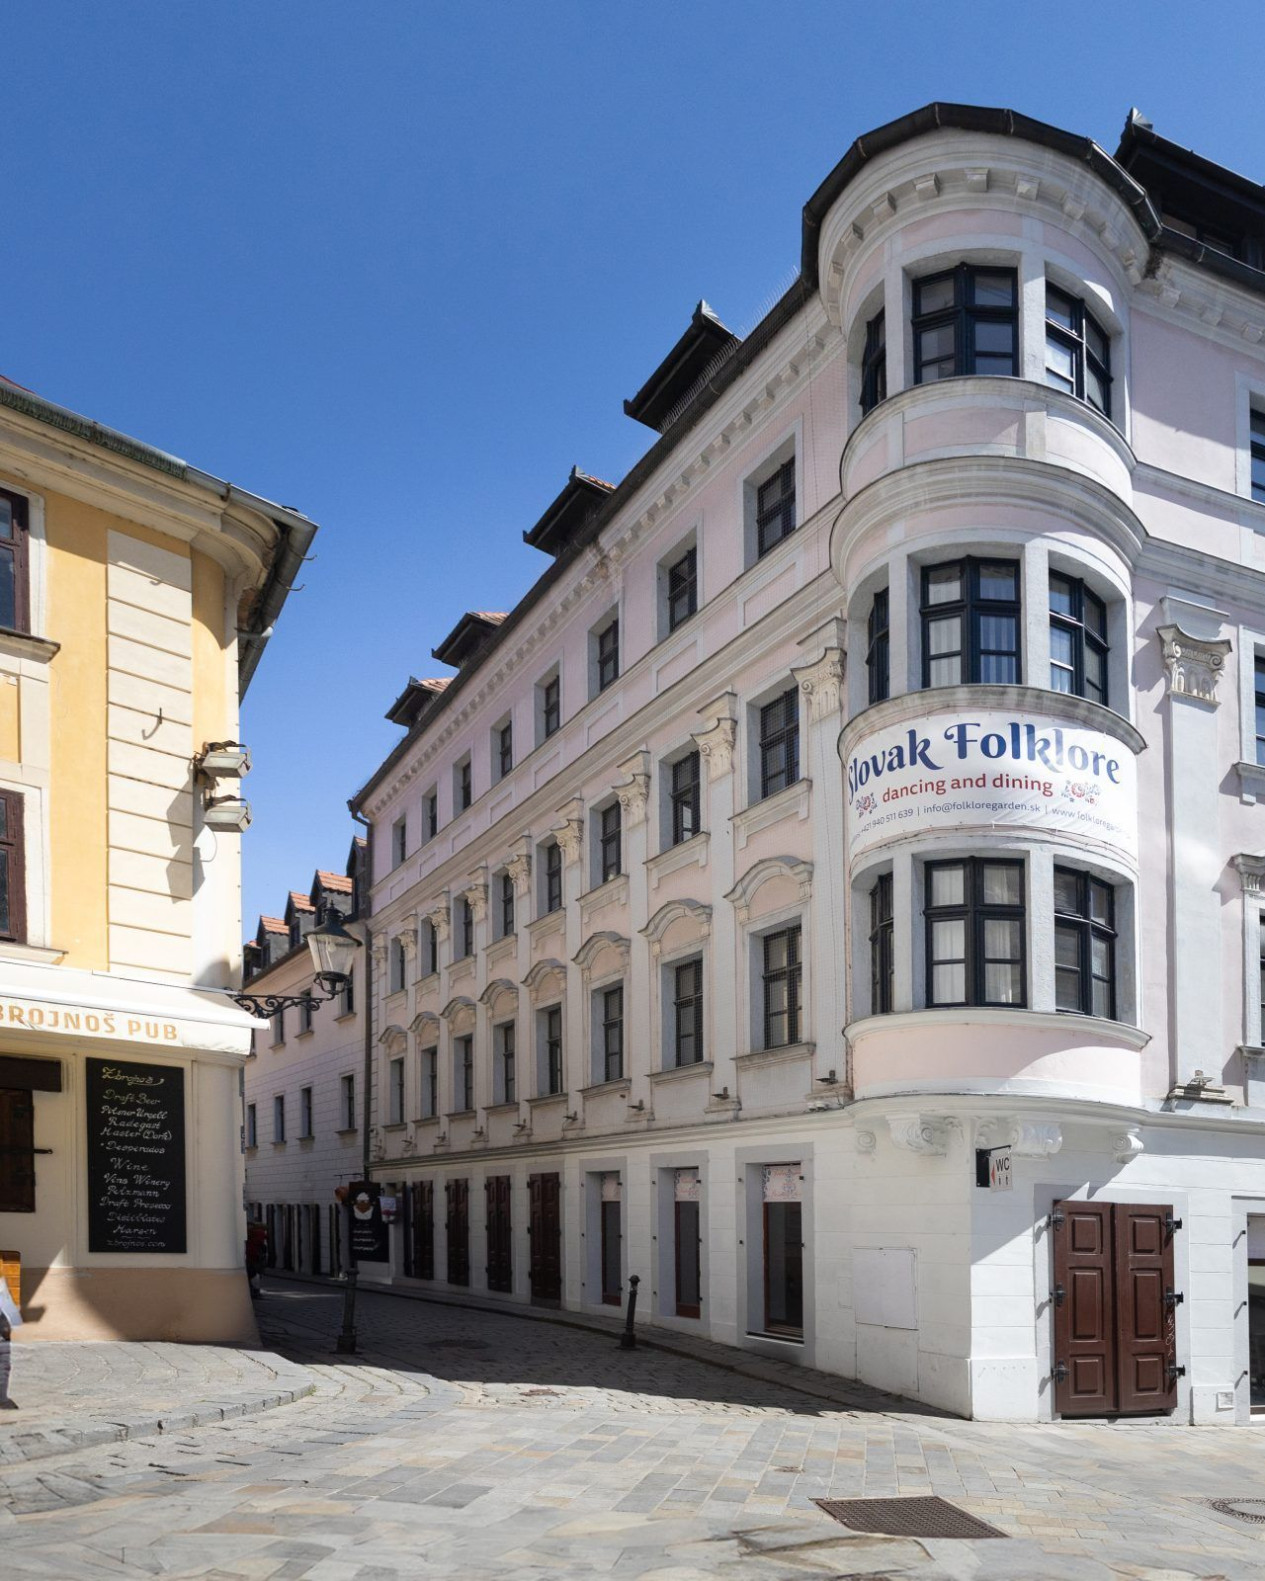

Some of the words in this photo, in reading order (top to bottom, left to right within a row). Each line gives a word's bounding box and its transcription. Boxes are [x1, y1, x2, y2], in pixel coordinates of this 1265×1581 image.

[848, 728, 944, 806] Slovak
[944, 722, 1121, 785] Folklore
[882, 776, 946, 803] dancing
[950, 774, 986, 790] and
[992, 774, 1053, 797] dining
[898, 808, 914, 819] 639
[923, 801, 1041, 815] info@folkloregarden.sk
[0, 1004, 116, 1034] ROJNOŠ
[127, 1019, 178, 1041] PUB
[102, 1089, 135, 1105] Draft
[100, 1126, 140, 1138] Master
[108, 1116, 161, 1132] Radegast
[110, 1157, 149, 1171] Wine
[995, 1157, 1010, 1172] WC
[133, 1174, 171, 1191] Winery
[99, 1196, 130, 1209] Draft
